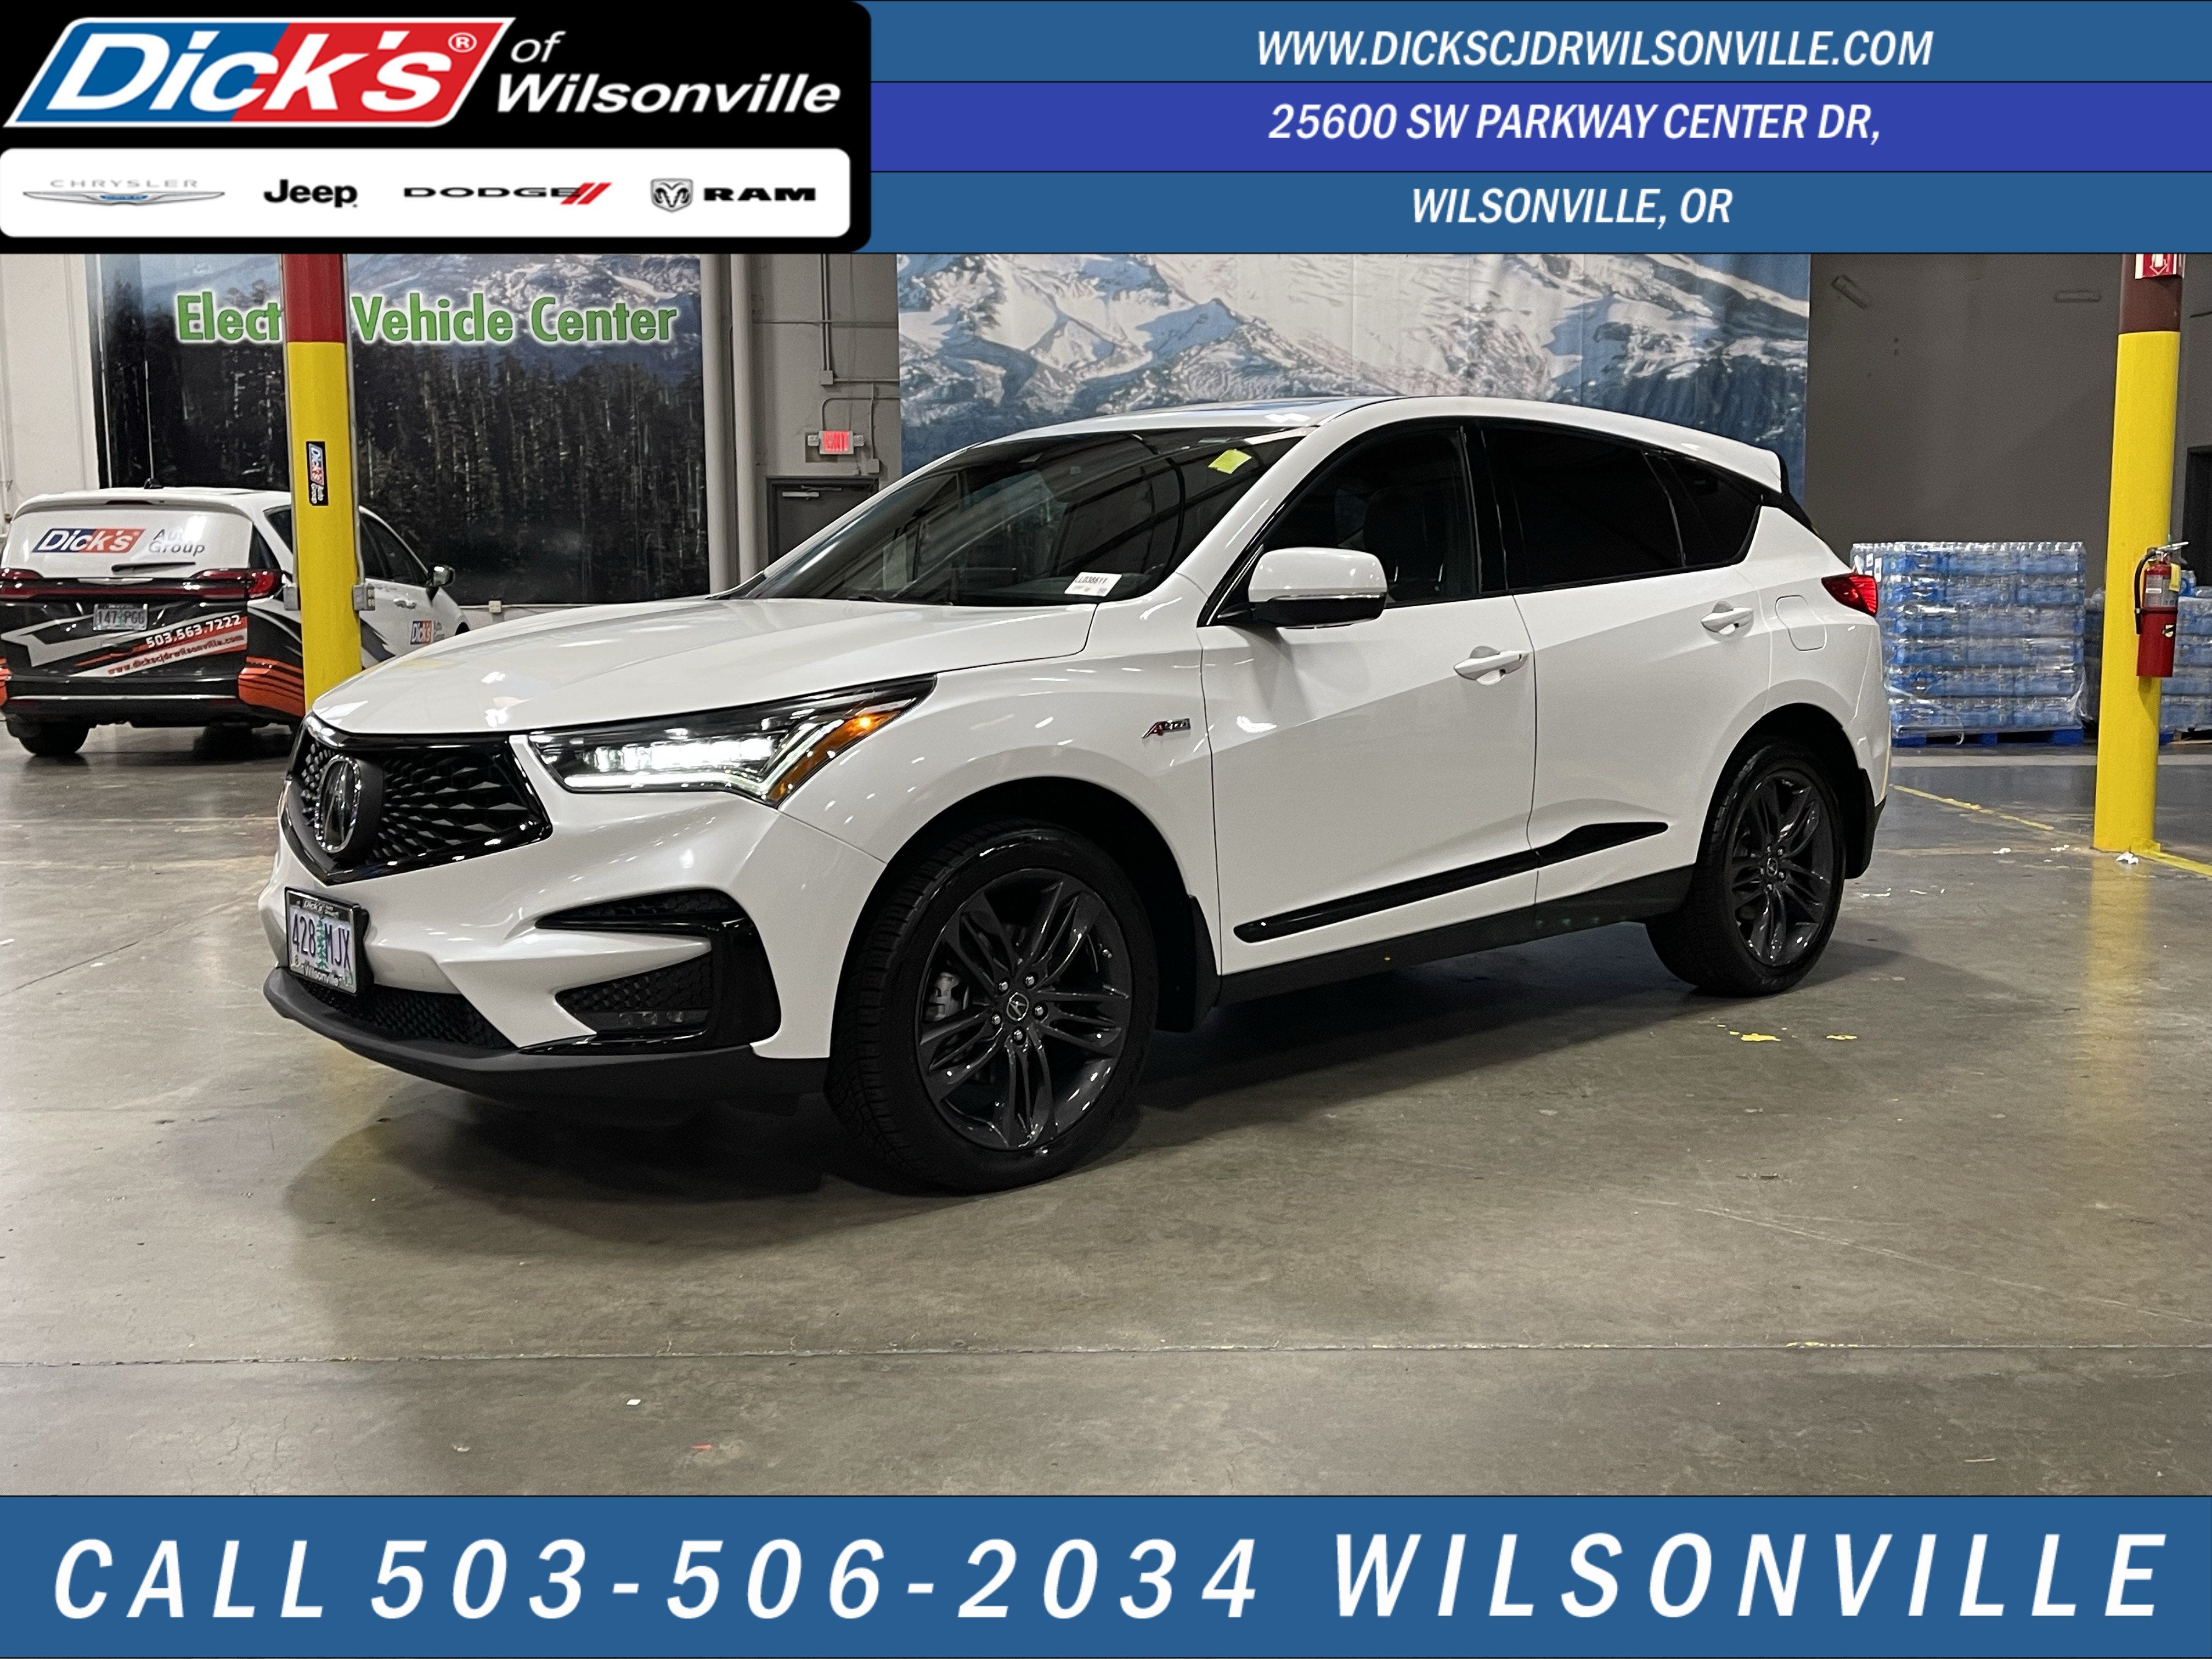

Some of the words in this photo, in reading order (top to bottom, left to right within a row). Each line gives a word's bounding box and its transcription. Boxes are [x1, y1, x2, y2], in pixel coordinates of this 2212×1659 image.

[177, 291, 283, 341] Elect
[351, 292, 514, 342] Vehicle
[531, 296, 678, 342] Center
[148, 540, 205, 556] Group
[145, 614, 242, 648] 503.563.7222
[292, 913, 316, 958] 428
